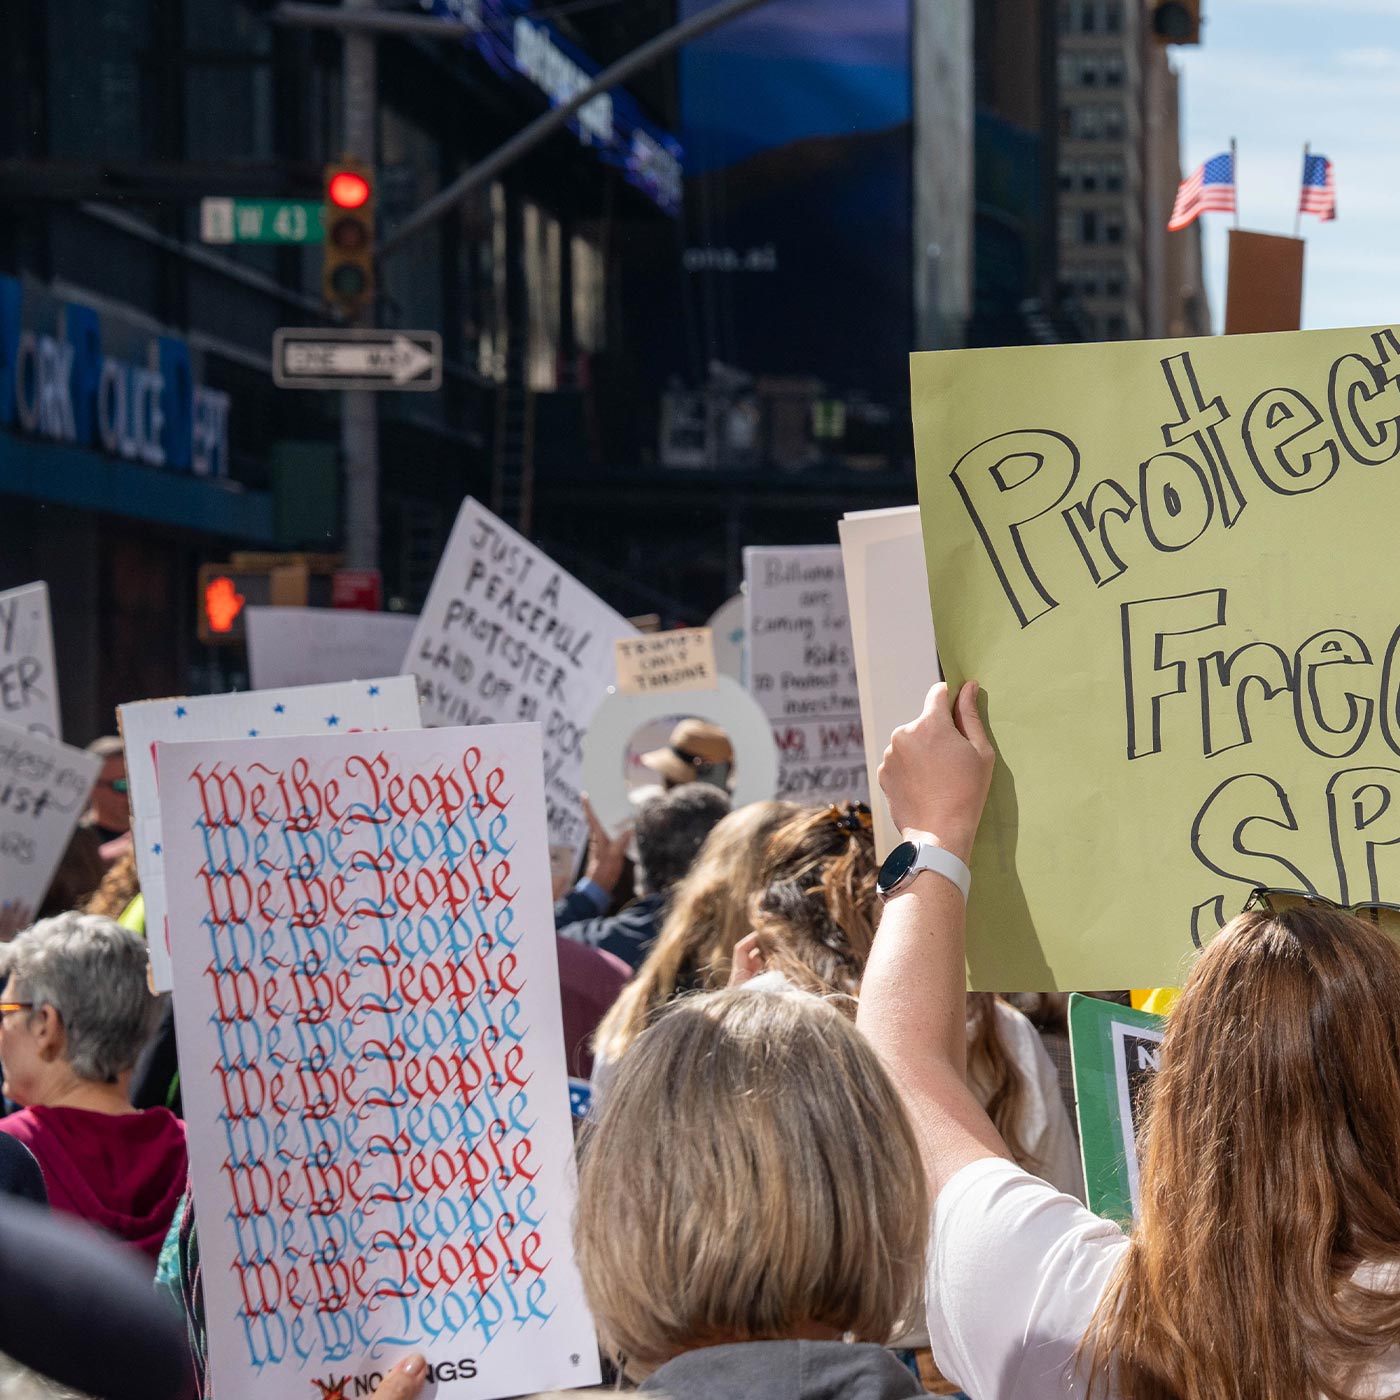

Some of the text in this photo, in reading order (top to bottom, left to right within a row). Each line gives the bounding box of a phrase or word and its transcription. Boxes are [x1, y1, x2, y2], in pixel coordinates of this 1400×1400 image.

[237, 206, 263, 240] W
[273, 205, 307, 241] 43
[469, 517, 561, 611] JUST A
[419, 637, 475, 687] LAID
[783, 692, 859, 714] investm
[188, 762, 279, 836] We
[277, 757, 347, 833] the
[341, 747, 516, 838] People
[192, 811, 282, 885] We
[281, 806, 350, 881] the
[344, 794, 520, 885] People
[197, 840, 523, 934] We the People
[201, 887, 527, 983] We the People
[205, 934, 531, 1032] We the People
[209, 980, 535, 1081] We the People
[214, 1027, 538, 1131] We the People
[218, 1073, 542, 1180] We the People
[222, 1120, 546, 1229] We the People
[226, 1167, 550, 1278] We the People
[231, 1213, 553, 1327] We the People
[235, 1260, 557, 1376] We the People
[424, 1358, 478, 1384] NGS
